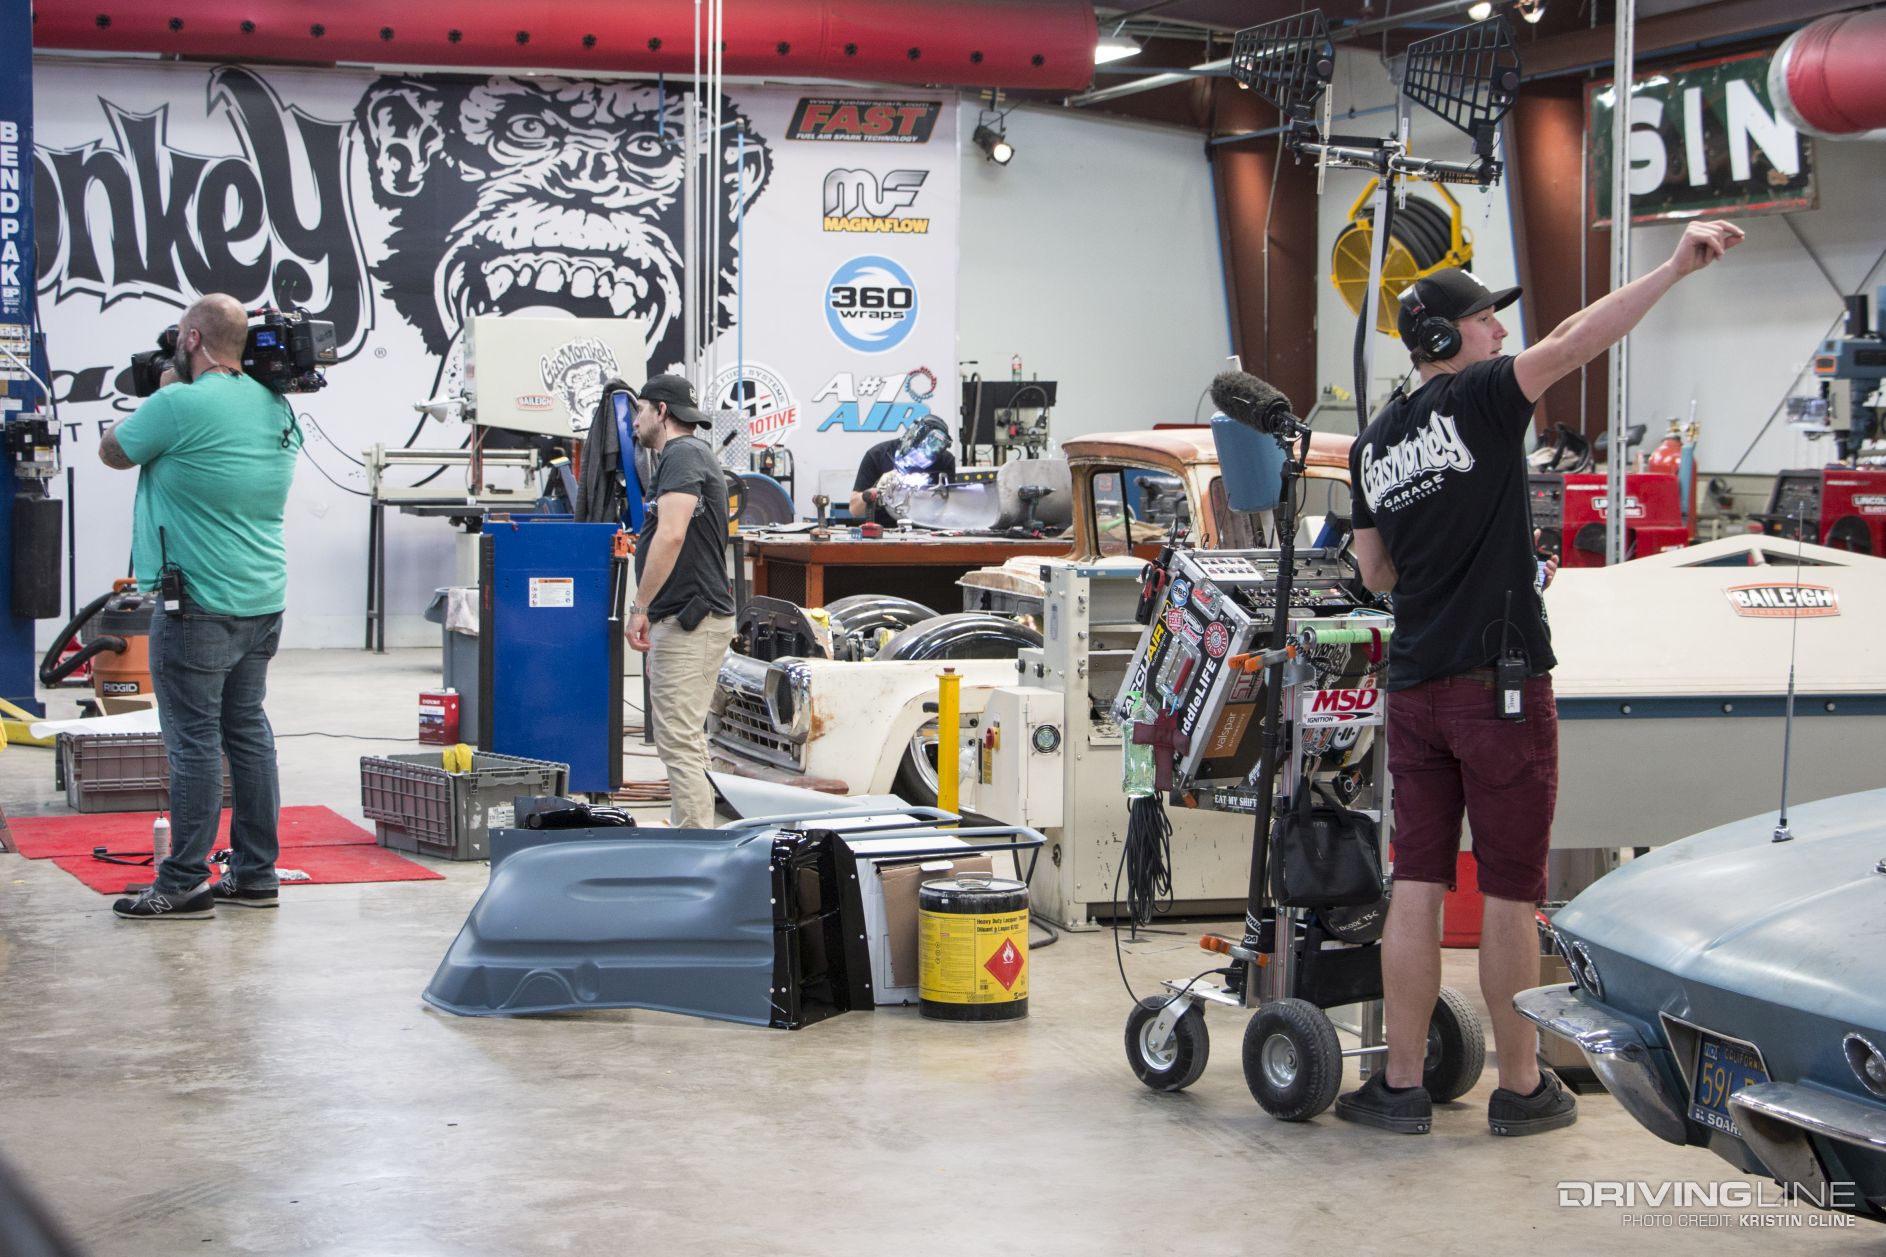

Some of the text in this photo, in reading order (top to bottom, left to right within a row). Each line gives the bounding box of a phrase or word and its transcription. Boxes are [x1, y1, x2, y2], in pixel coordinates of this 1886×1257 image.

[800, 105, 927, 135] FAST
[0, 121, 20, 286] BENDPAK
[823, 216, 929, 233] MAGNAFLOW
[832, 286, 912, 309] 360
[840, 310, 904, 320] wraps
[816, 402, 931, 432] AIR
[1384, 473, 1445, 508] GARAGE
[1416, 485, 1443, 500] TEXAS
[1732, 587, 1833, 607] BAILEIGH
[103, 683, 138, 692] RIDGID
[1311, 689, 1378, 713] MSD
[1215, 712, 1238, 751] valspar
[1307, 716, 1333, 724] IGNITION
[1214, 794, 1226, 804] EAT
[1228, 796, 1238, 805] MY
[1707, 1113, 1742, 1136] SOAR
